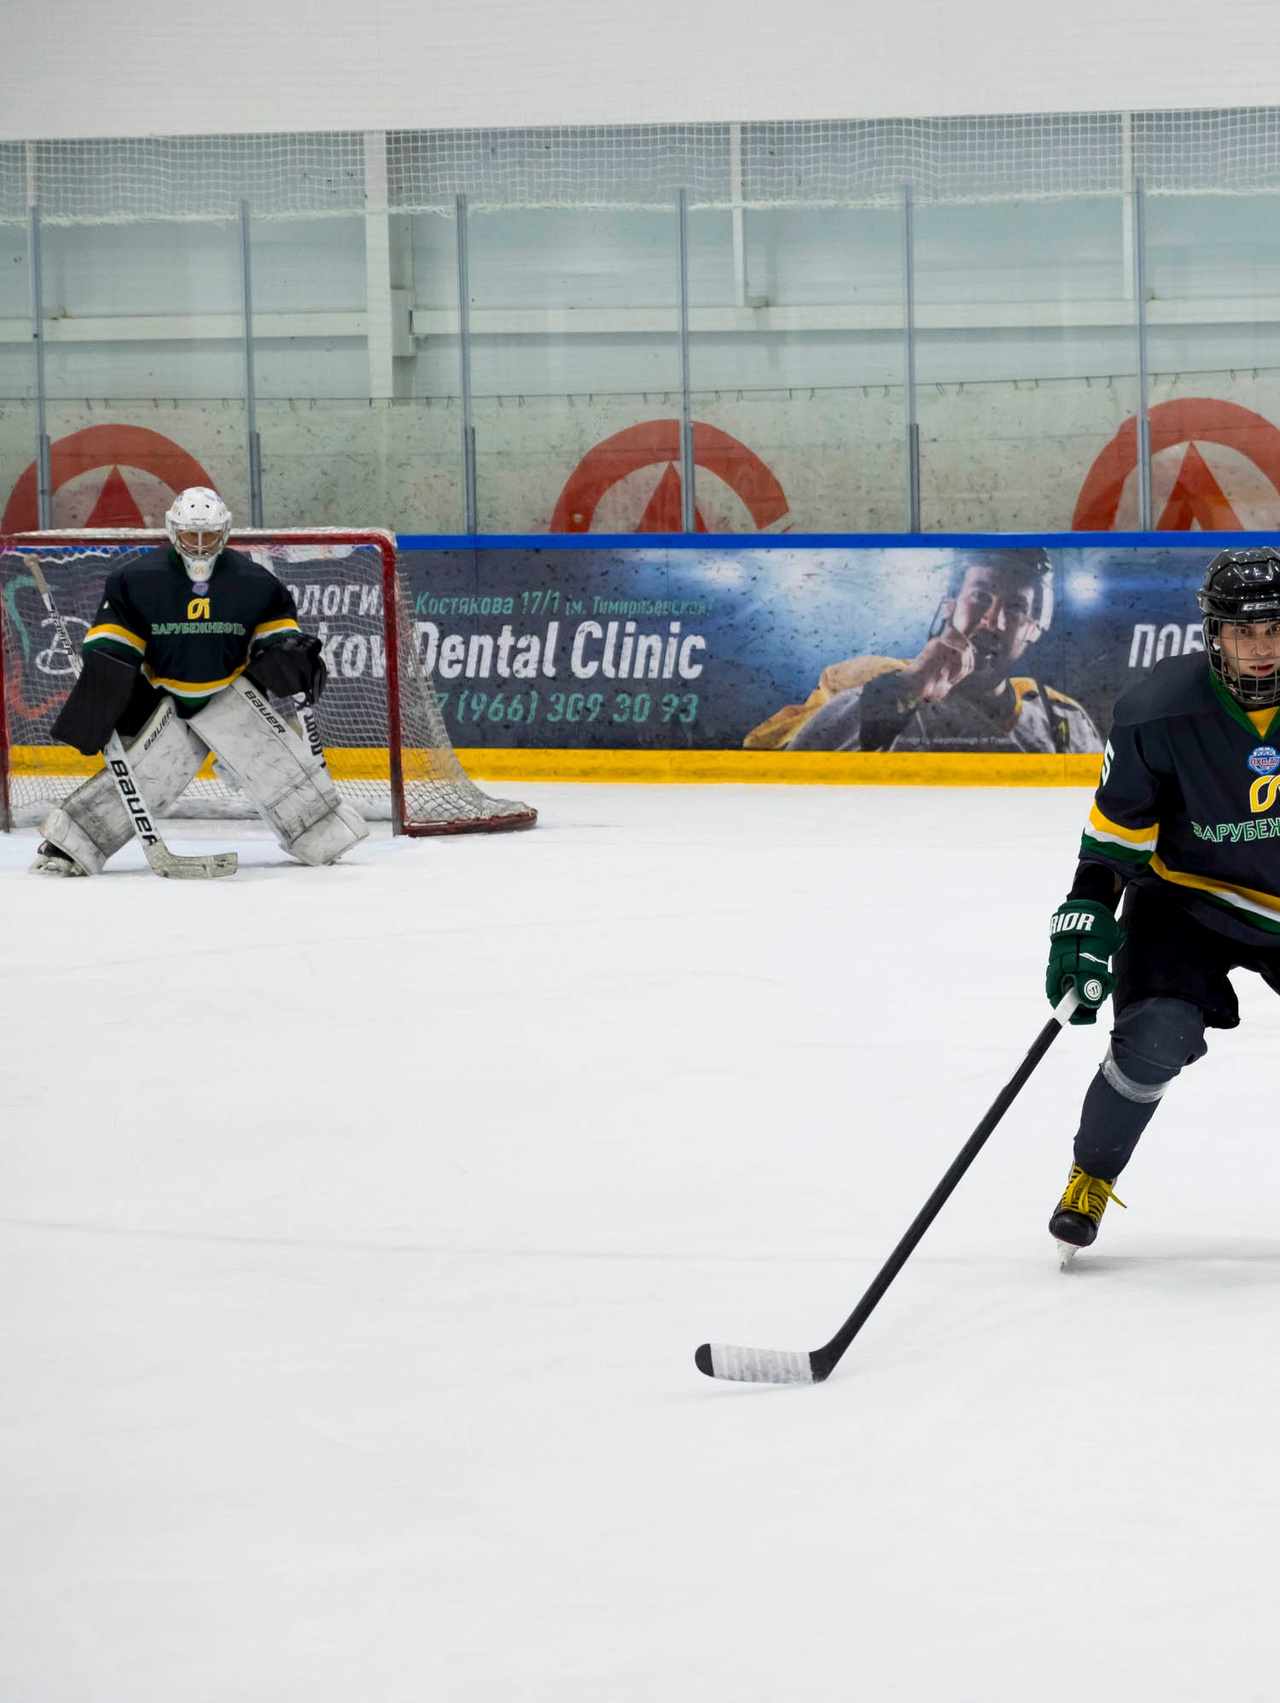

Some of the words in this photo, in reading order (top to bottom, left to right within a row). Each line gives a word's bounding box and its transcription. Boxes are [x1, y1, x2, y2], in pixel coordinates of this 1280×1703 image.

[415, 591, 514, 616] Костякова
[521, 589, 560, 615] 17/1
[151, 622, 246, 636] ЗАРУБЕЖНЕФТЬ
[408, 621, 560, 679] Dental
[571, 620, 707, 680] Clinic
[456, 689, 538, 724] (966)
[547, 691, 604, 723] 309
[612, 692, 651, 723] 30
[661, 692, 700, 723] 93
